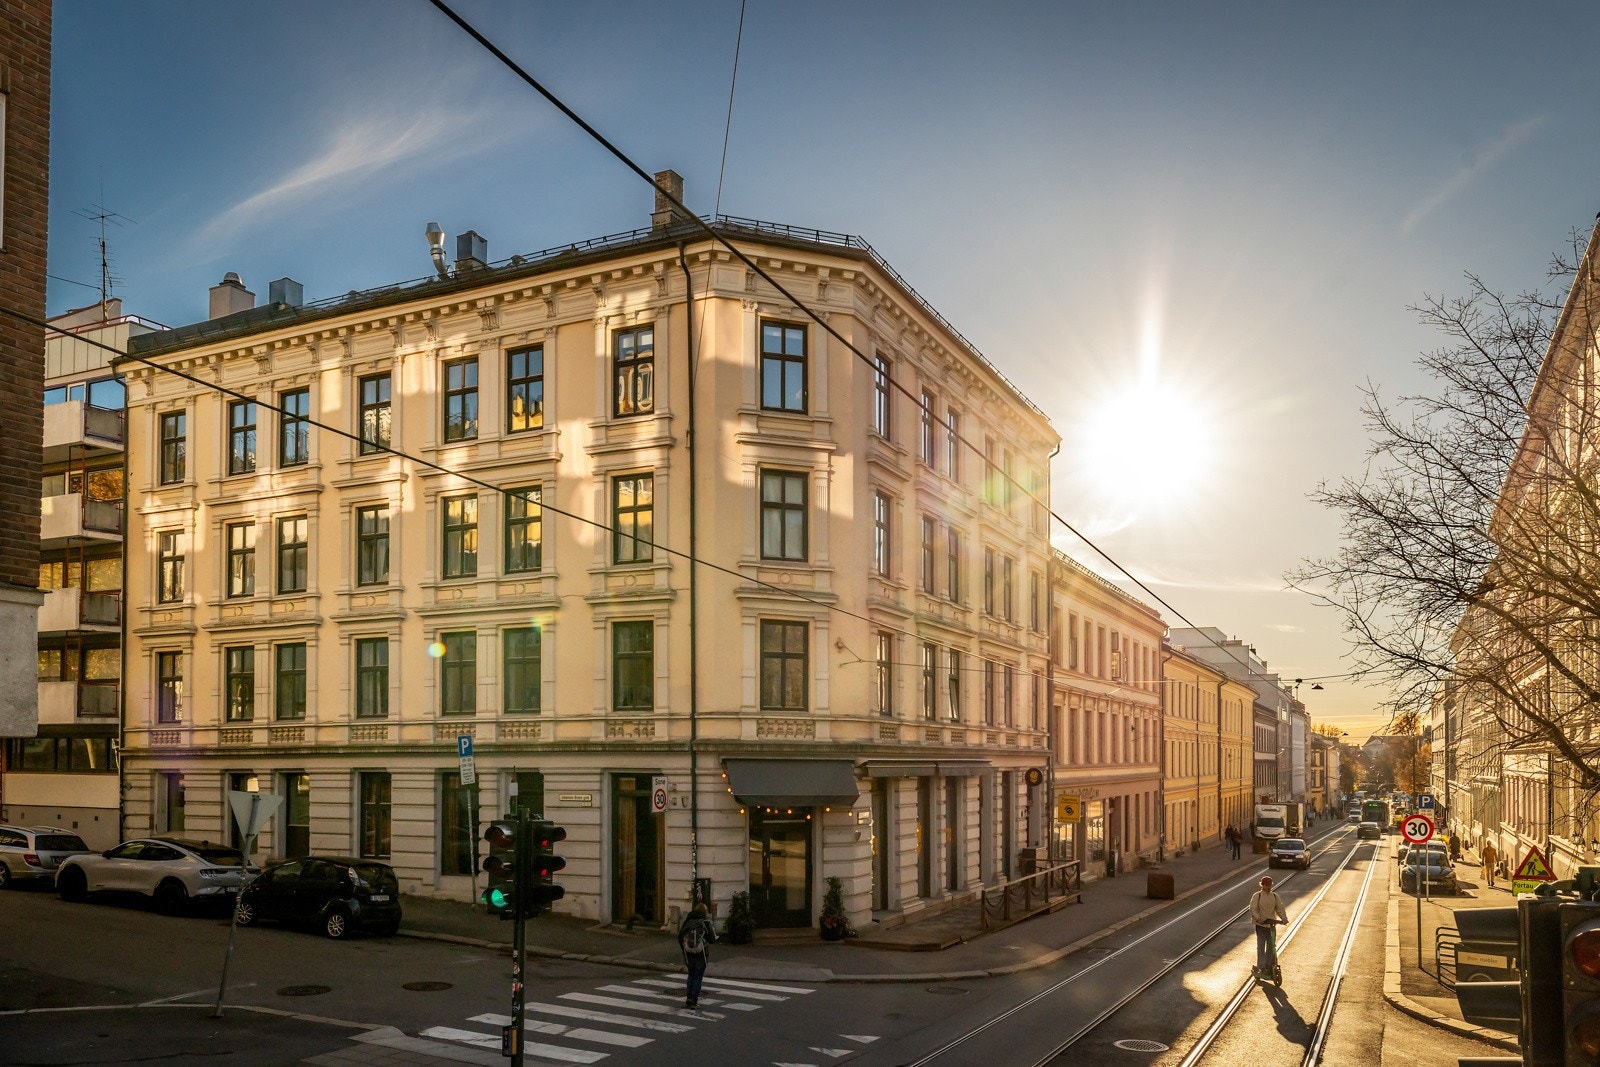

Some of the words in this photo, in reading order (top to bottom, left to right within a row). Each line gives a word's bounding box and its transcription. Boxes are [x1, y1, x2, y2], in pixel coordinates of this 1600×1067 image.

[461, 738, 469, 754] P
[654, 778, 666, 786] Sone
[656, 794, 665, 804] 30
[1421, 796, 1431, 807] P
[1407, 822, 1428, 836] 30
